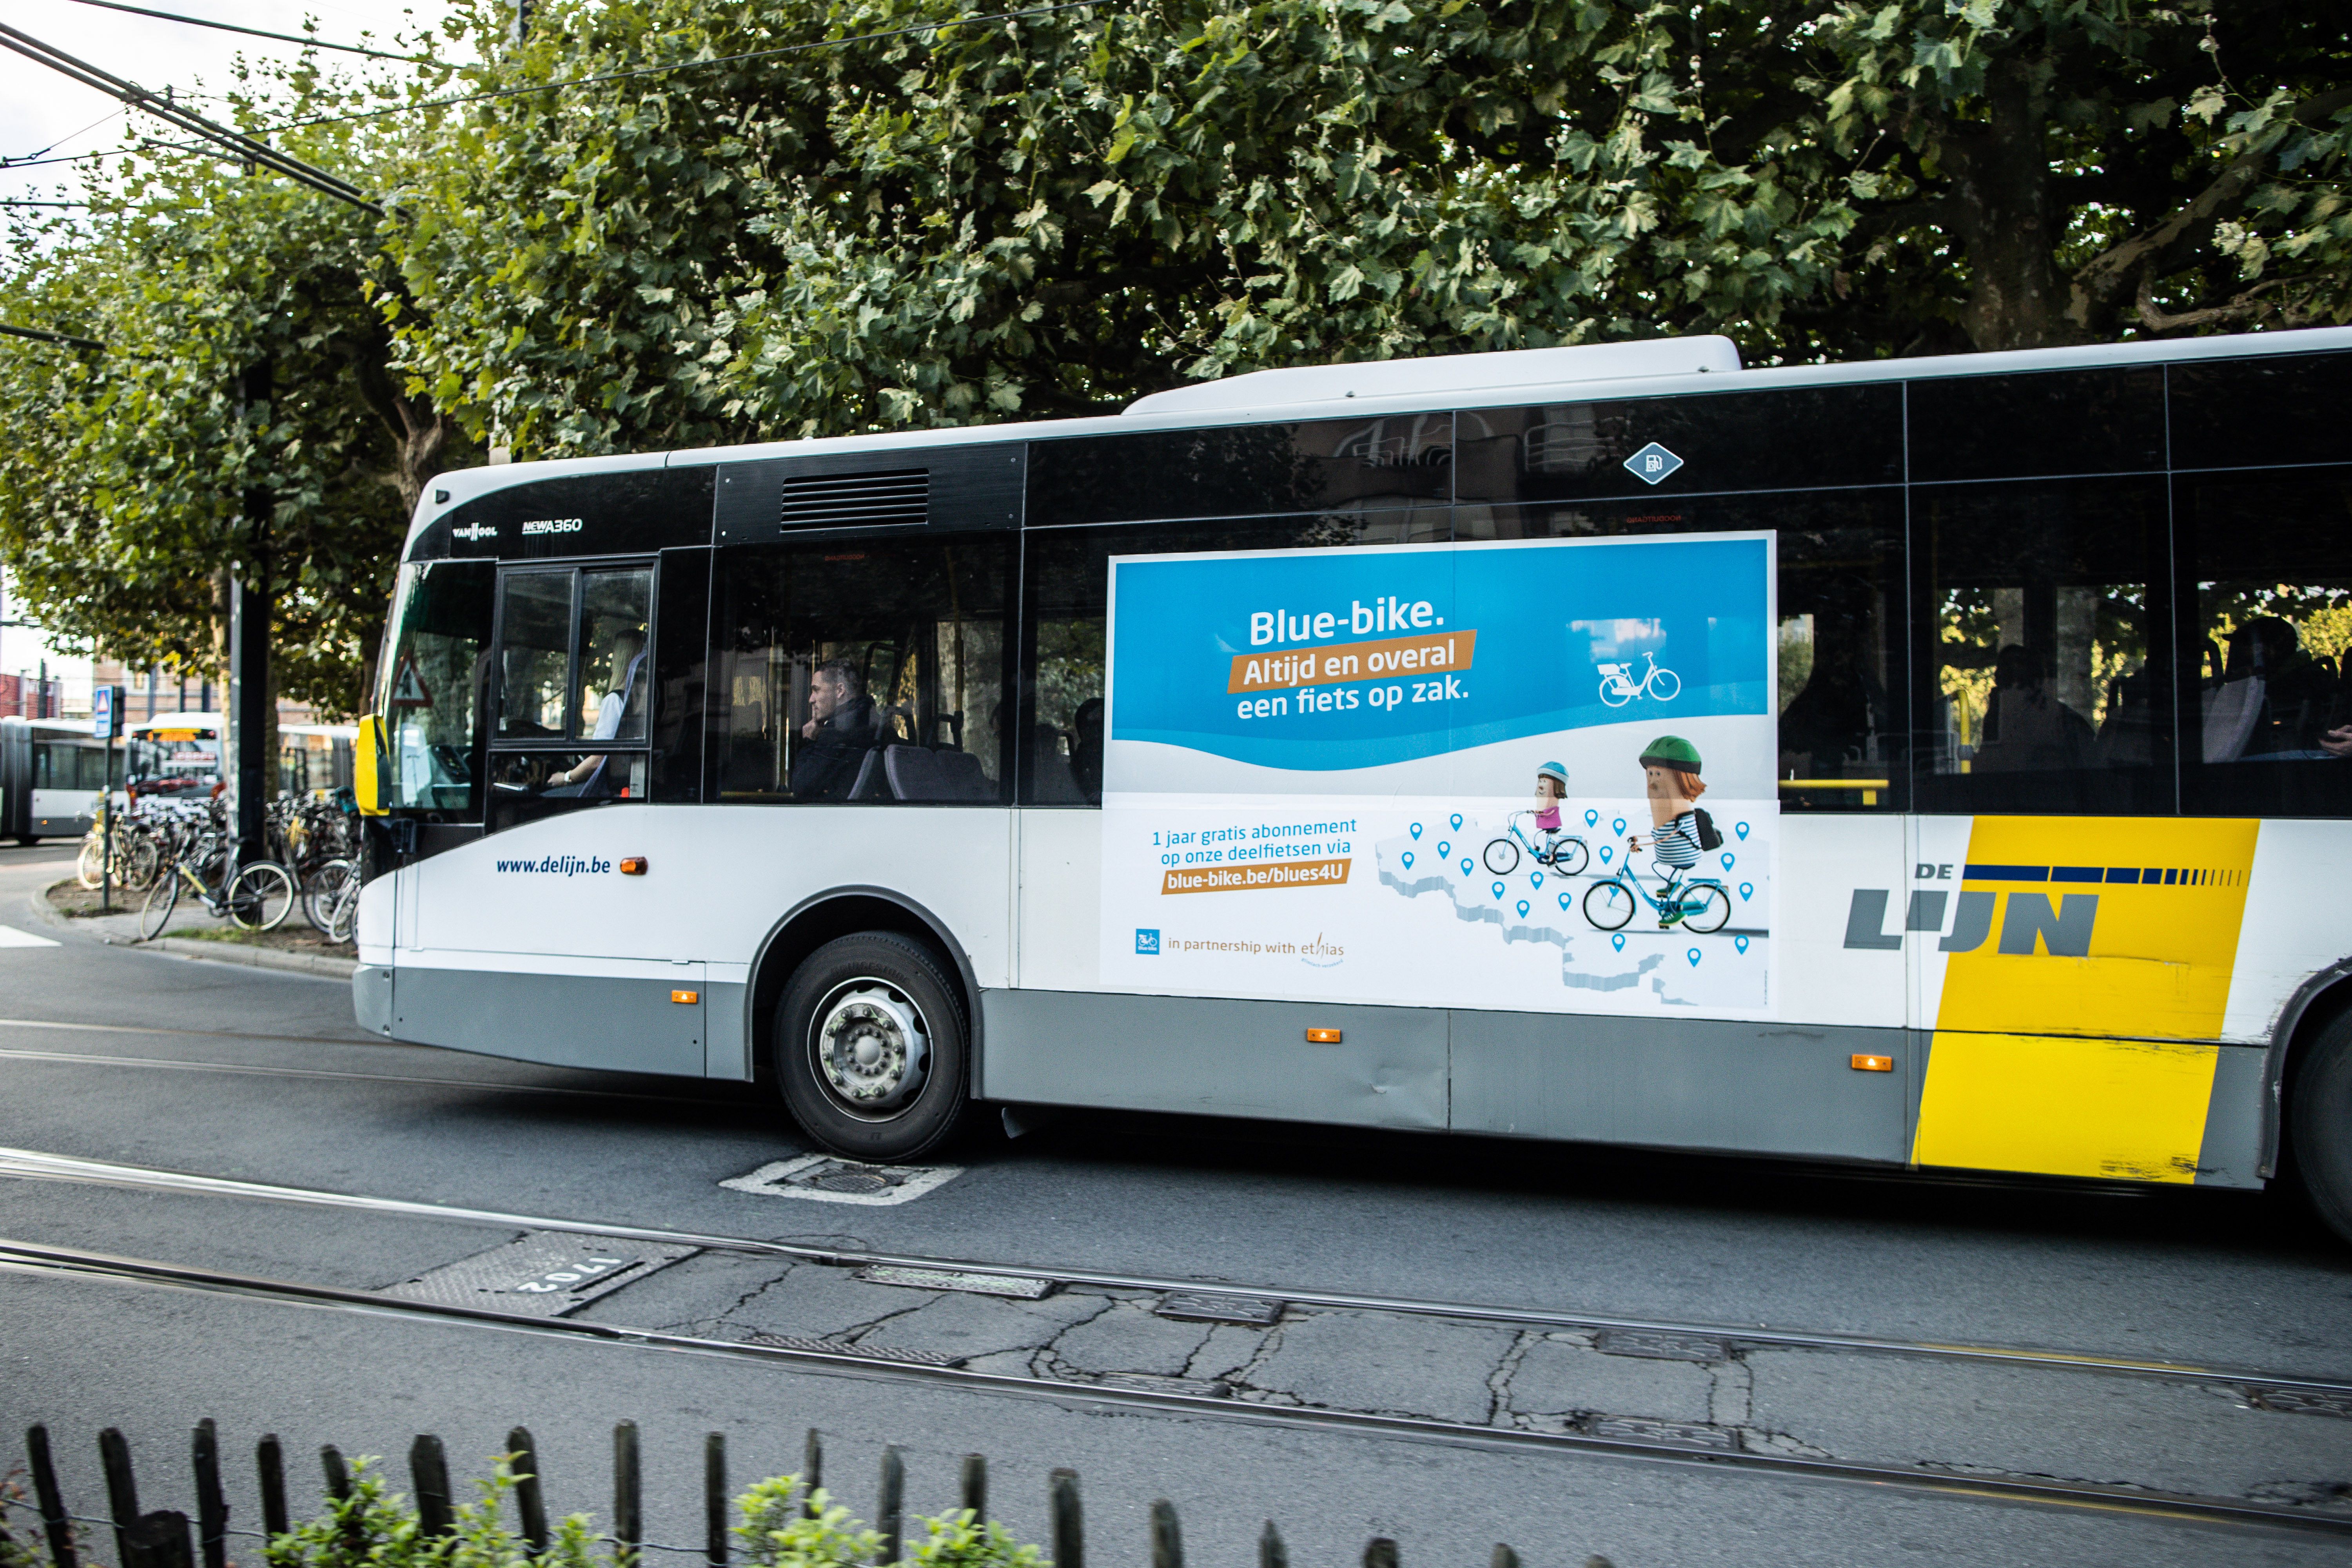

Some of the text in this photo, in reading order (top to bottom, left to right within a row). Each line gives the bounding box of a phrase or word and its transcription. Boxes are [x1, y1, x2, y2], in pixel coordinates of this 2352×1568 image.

[1250, 596, 1444, 645] Blue-bike.
[1243, 639, 1454, 687] Altijd en overal
[1238, 675, 1468, 719] een fiets op zak.
[1153, 818, 1357, 848] 1 jaar gratis abonnement
[497, 855, 610, 877] www.delijn.be
[1161, 838, 1351, 867] op onze deelfietsen via
[1167, 864, 1343, 889] blue-bike.be/blues4U
[1915, 863, 1953, 879] DE
[1843, 889, 2099, 957] LIJN
[1169, 931, 1344, 959] in partnership with ethias
